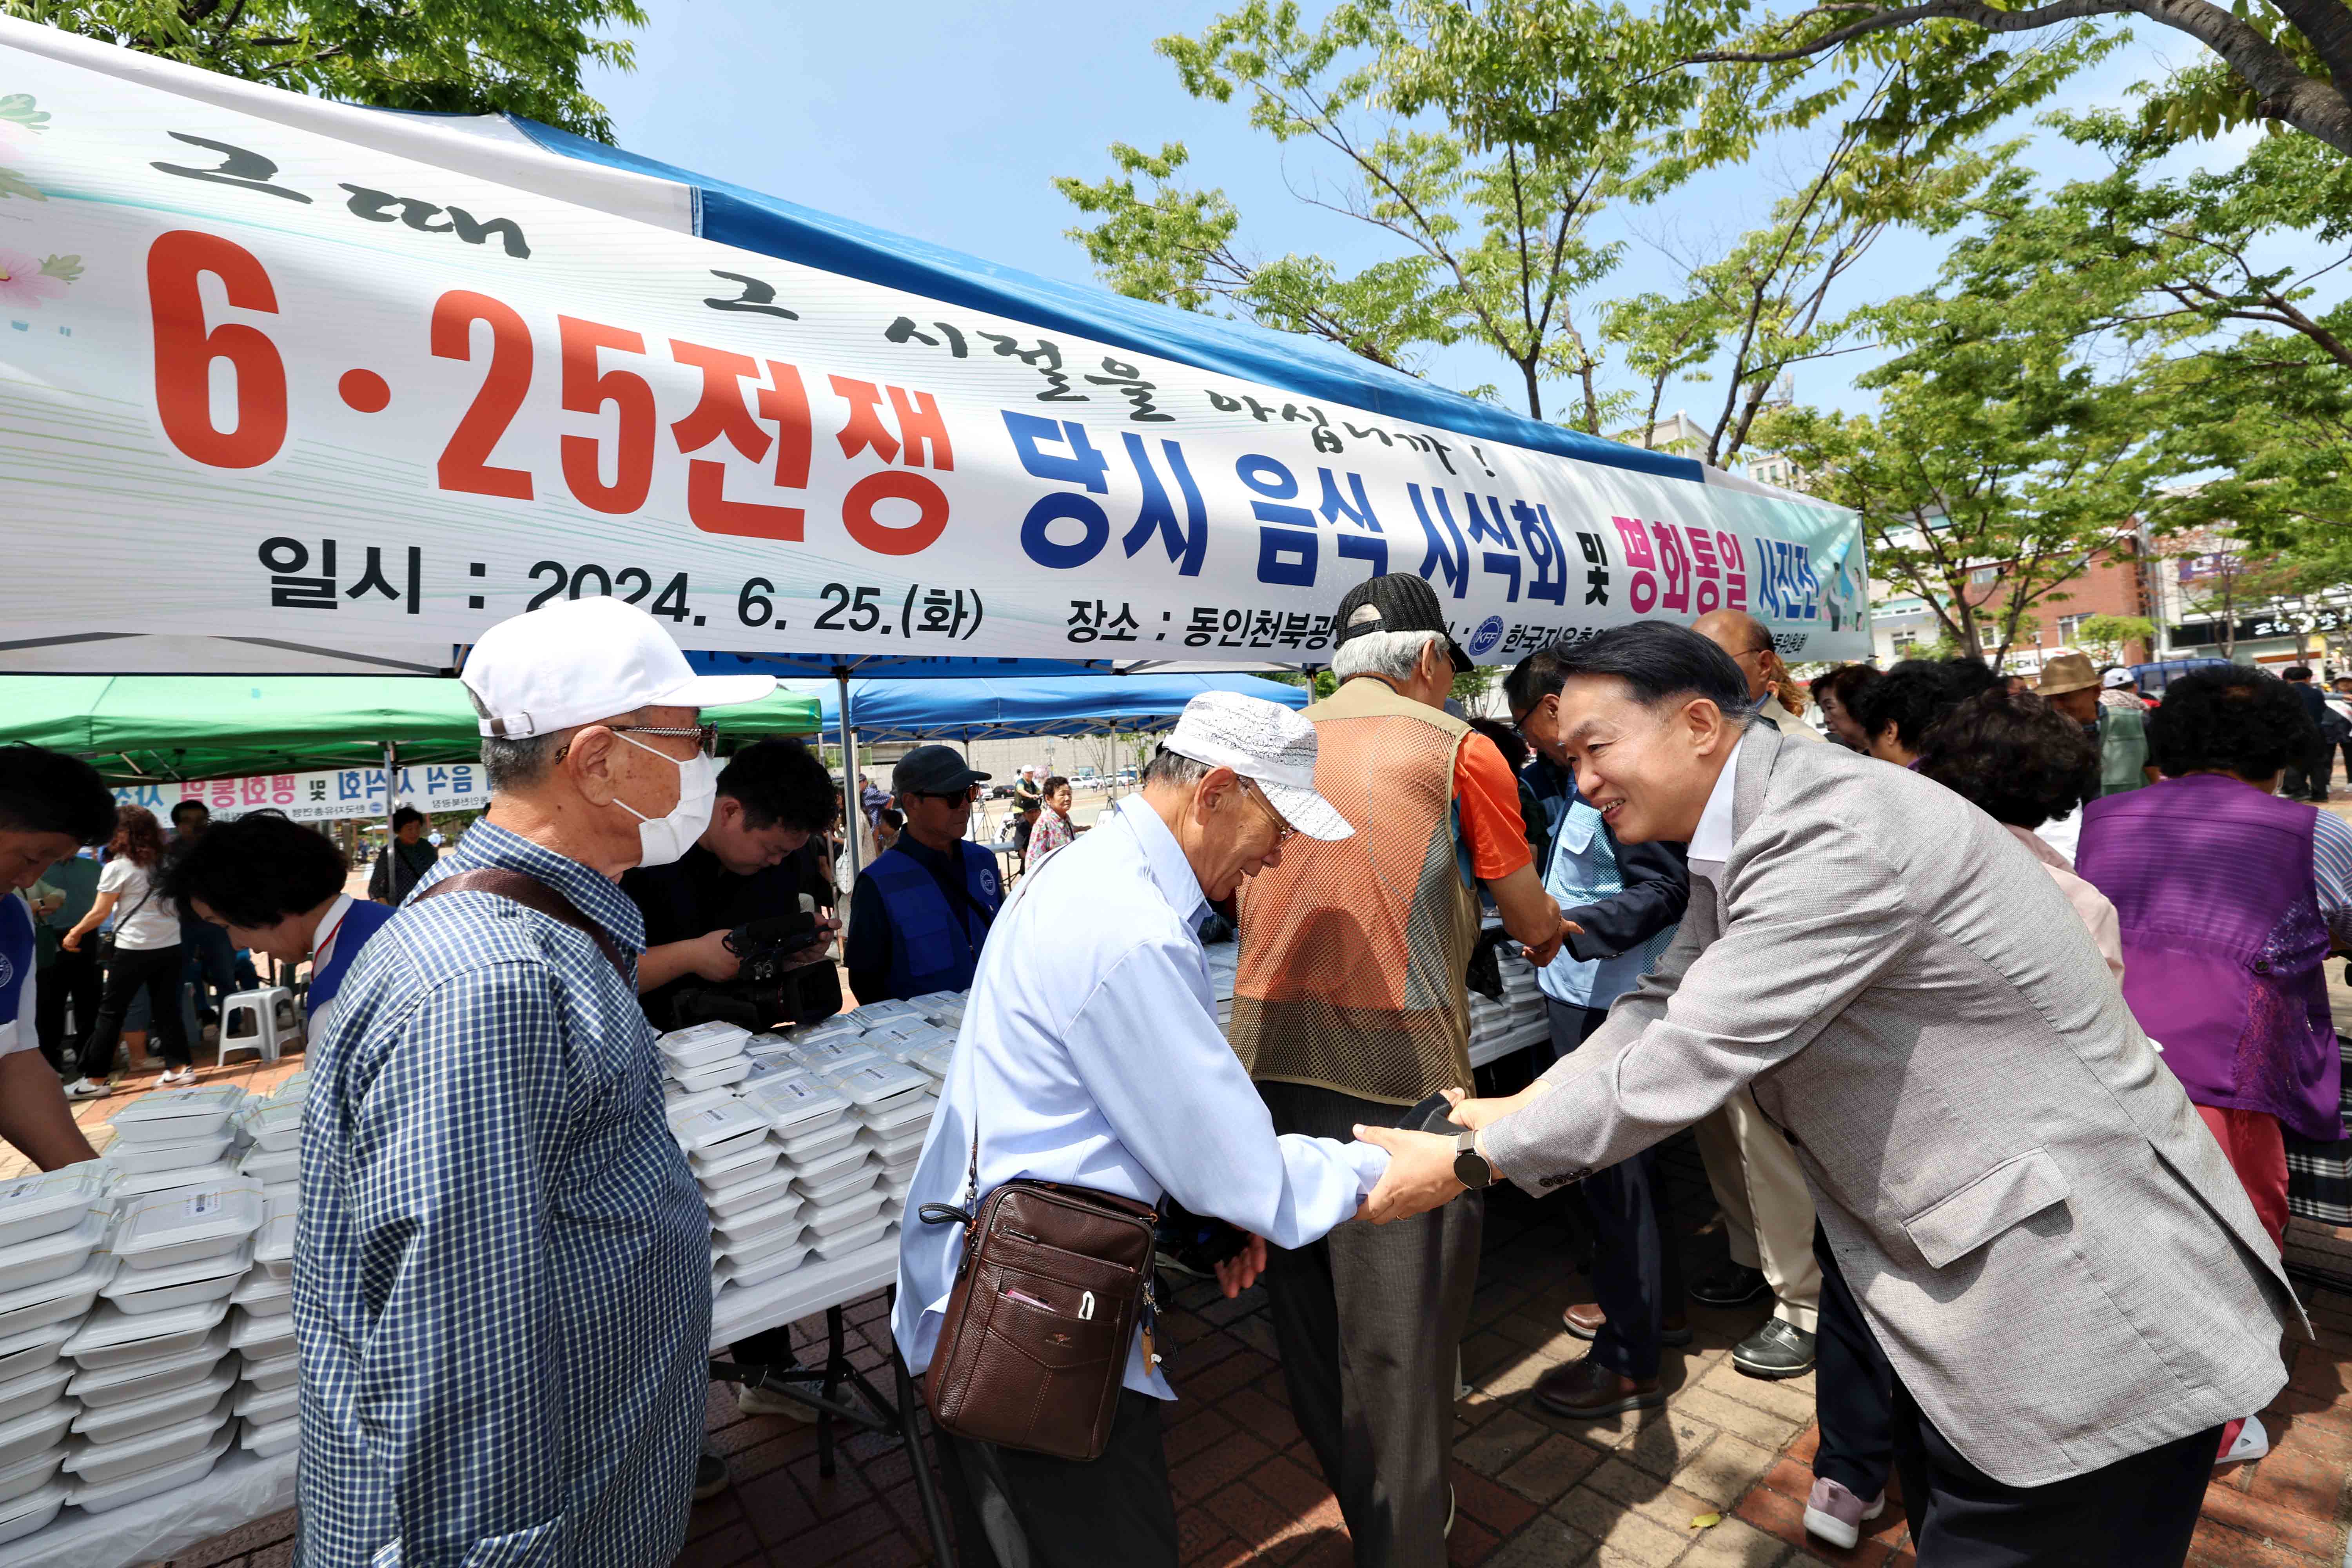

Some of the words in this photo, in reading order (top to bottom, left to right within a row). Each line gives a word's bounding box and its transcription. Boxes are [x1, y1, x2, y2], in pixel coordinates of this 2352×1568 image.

[884, 316, 1176, 422] 시절을
[1001, 410, 1208, 577] 당시
[1236, 453, 1388, 587] 음식
[1406, 482, 1567, 605] 시식회
[1575, 532, 1610, 606] 및
[1611, 516, 1748, 615] 평화통일
[1755, 537, 1820, 619] 사진전
[258, 536, 421, 615] 일시
[737, 577, 787, 630] 6.
[1066, 600, 1139, 644] 장소
[1185, 606, 1339, 651] 동인천북광
[1475, 632, 1498, 644] KFF
[1500, 624, 1601, 654] 한국자유총
